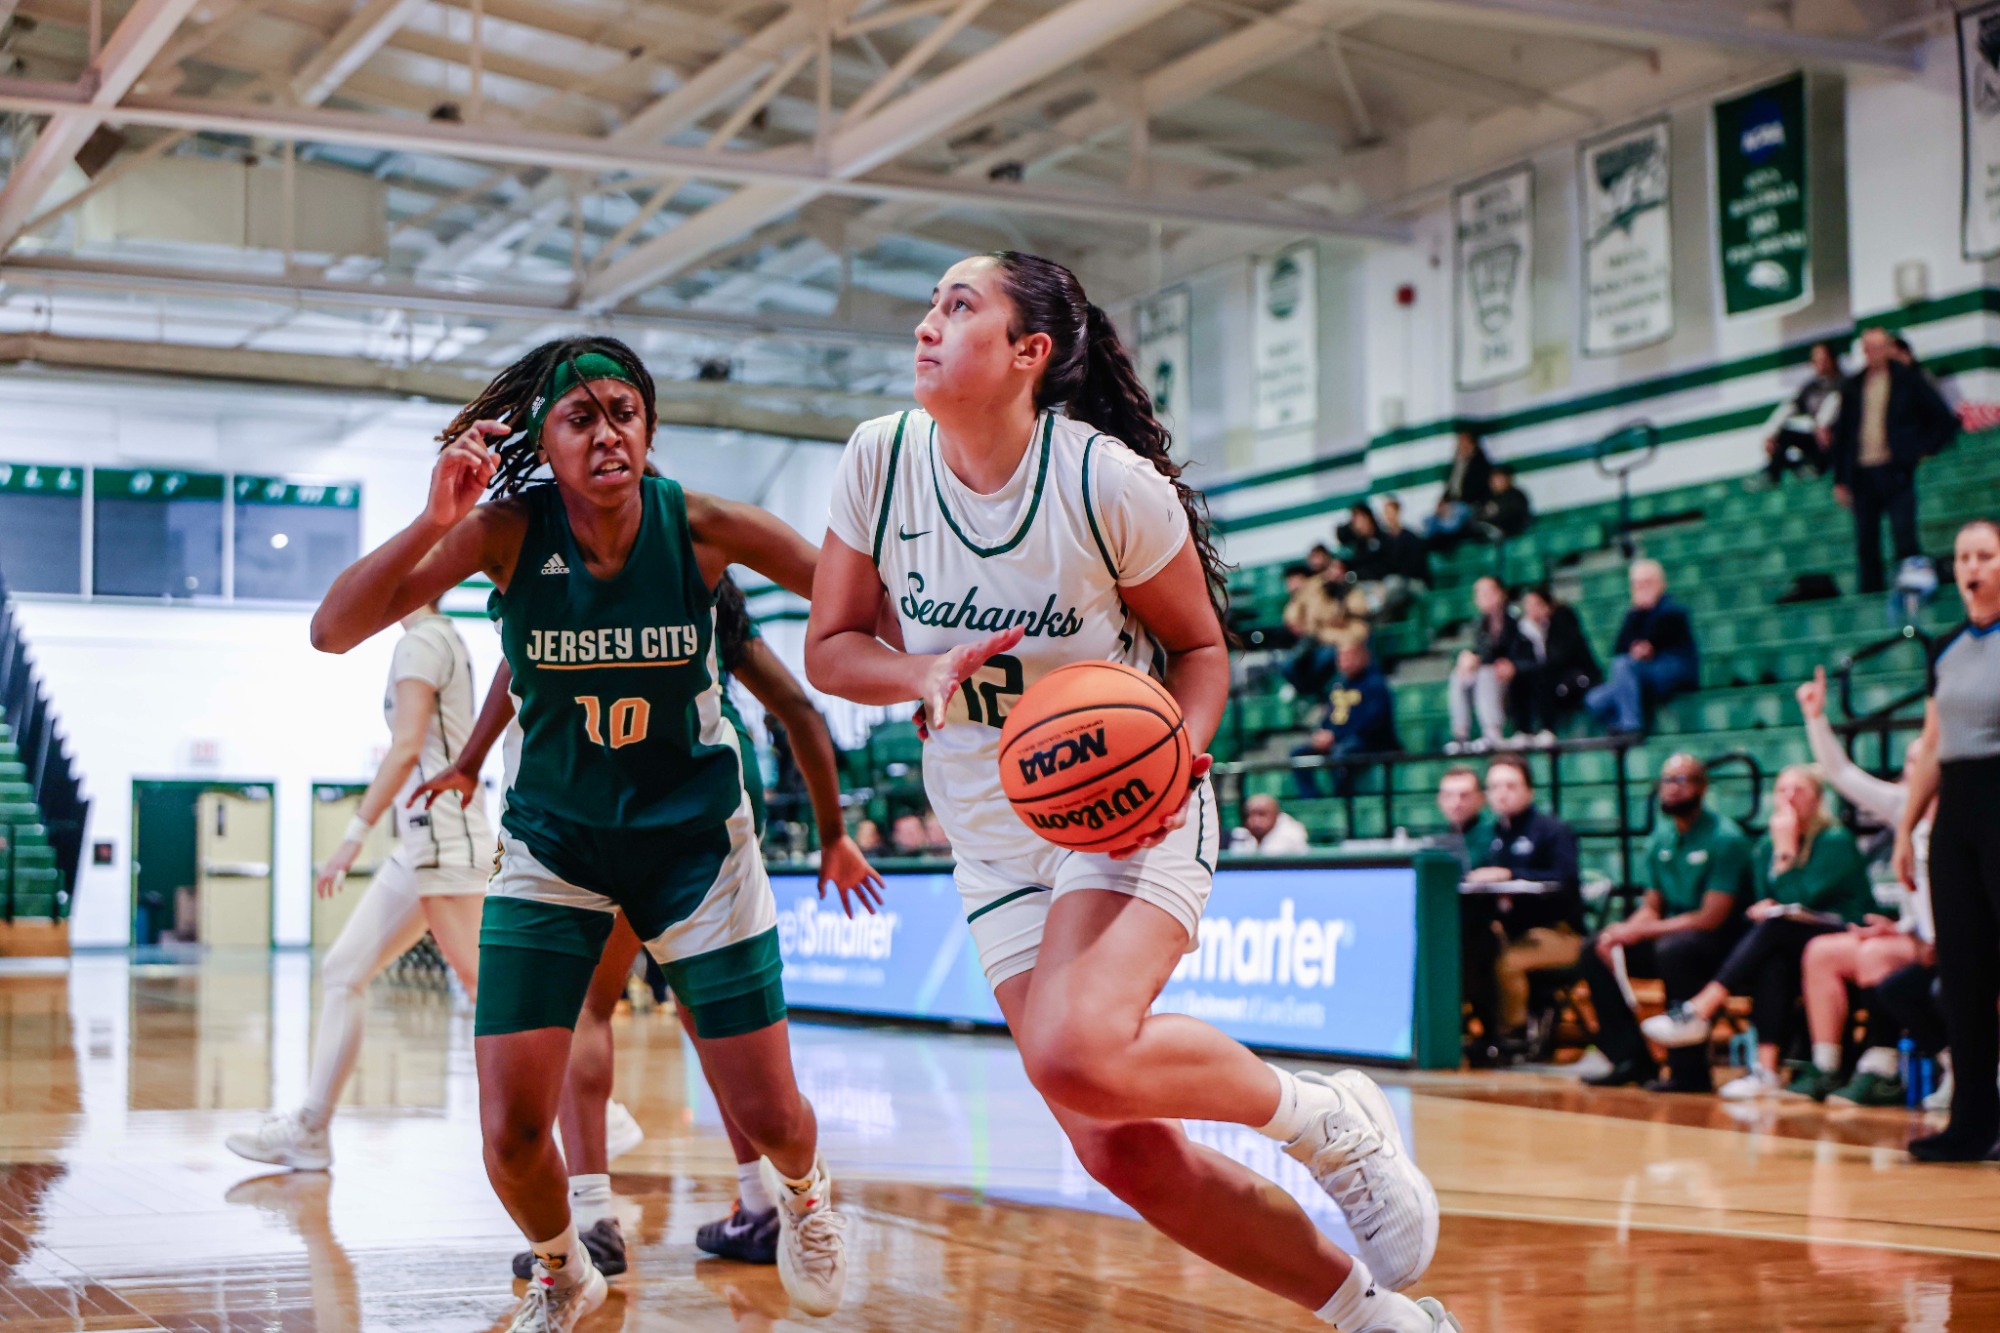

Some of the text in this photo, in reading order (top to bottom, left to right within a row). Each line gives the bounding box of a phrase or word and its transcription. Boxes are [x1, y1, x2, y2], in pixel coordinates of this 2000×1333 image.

[541, 566, 570, 576] adidas
[901, 572, 1084, 638] Seahawks
[527, 624, 698, 662] JERSEY CITY
[959, 653, 1024, 729] 12
[574, 695, 651, 749] 10
[1018, 728, 1107, 784] NCAA
[1028, 778, 1155, 829] Wilson
[1172, 898, 1345, 988] marter
